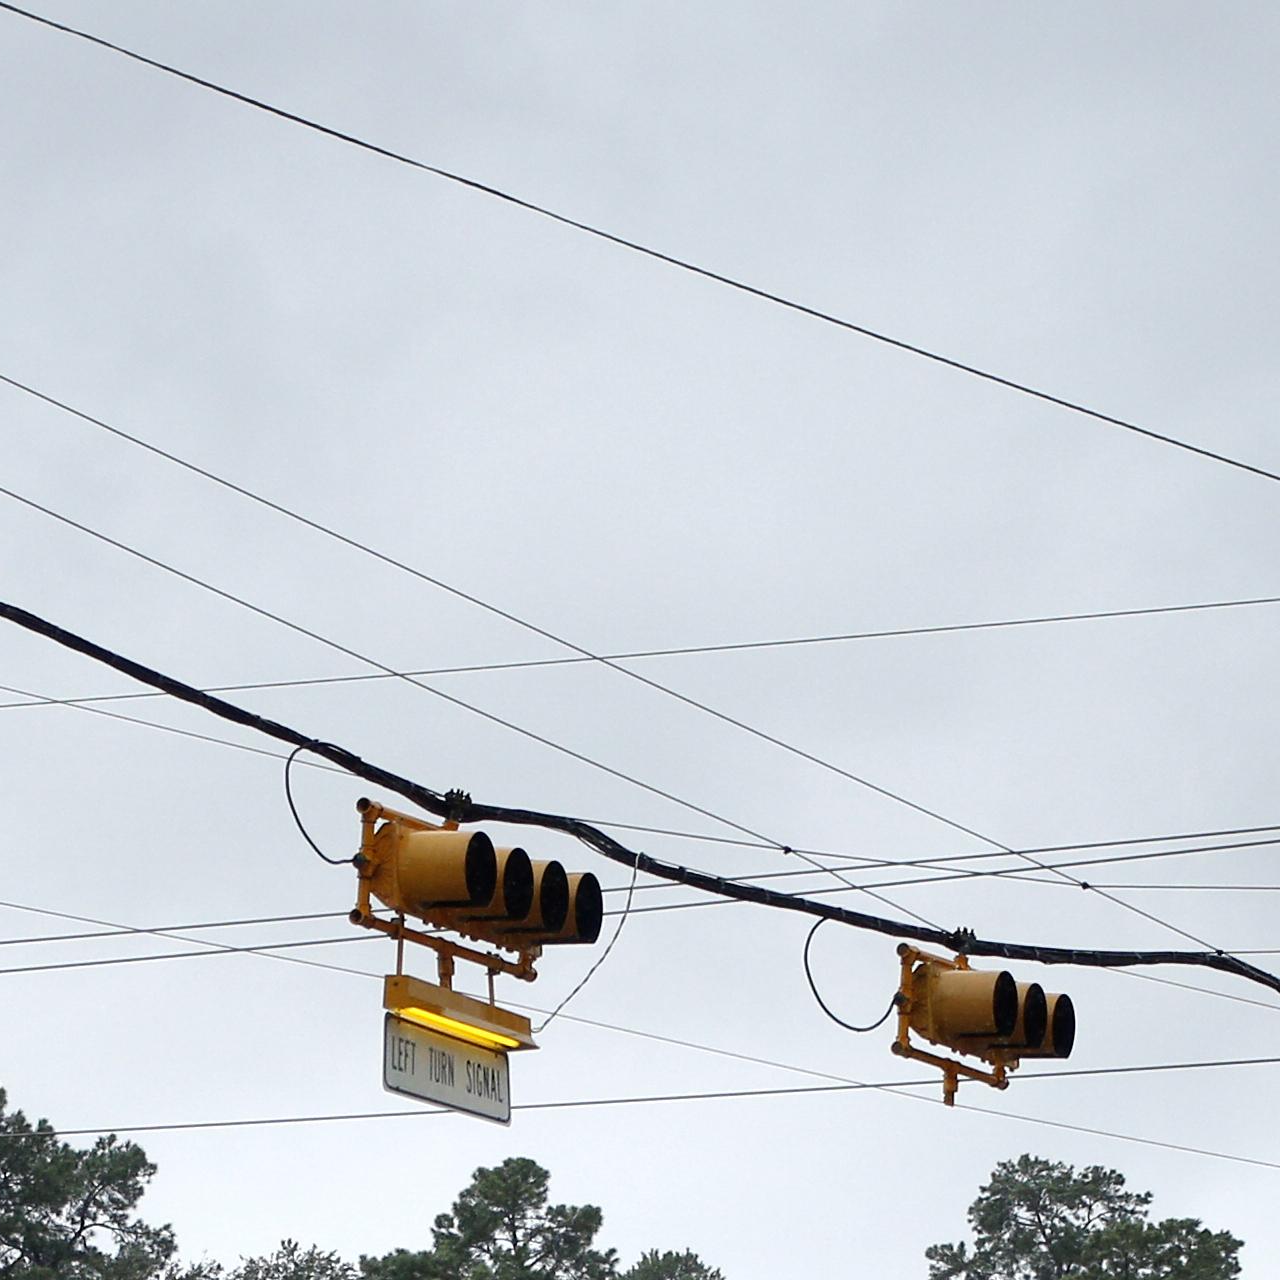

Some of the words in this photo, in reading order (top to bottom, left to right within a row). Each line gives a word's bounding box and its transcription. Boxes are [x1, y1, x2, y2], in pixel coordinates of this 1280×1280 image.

[391, 1035, 416, 1076] LEFT
[428, 1046, 455, 1088] TURN
[465, 1059, 503, 1104] SIGNAL
